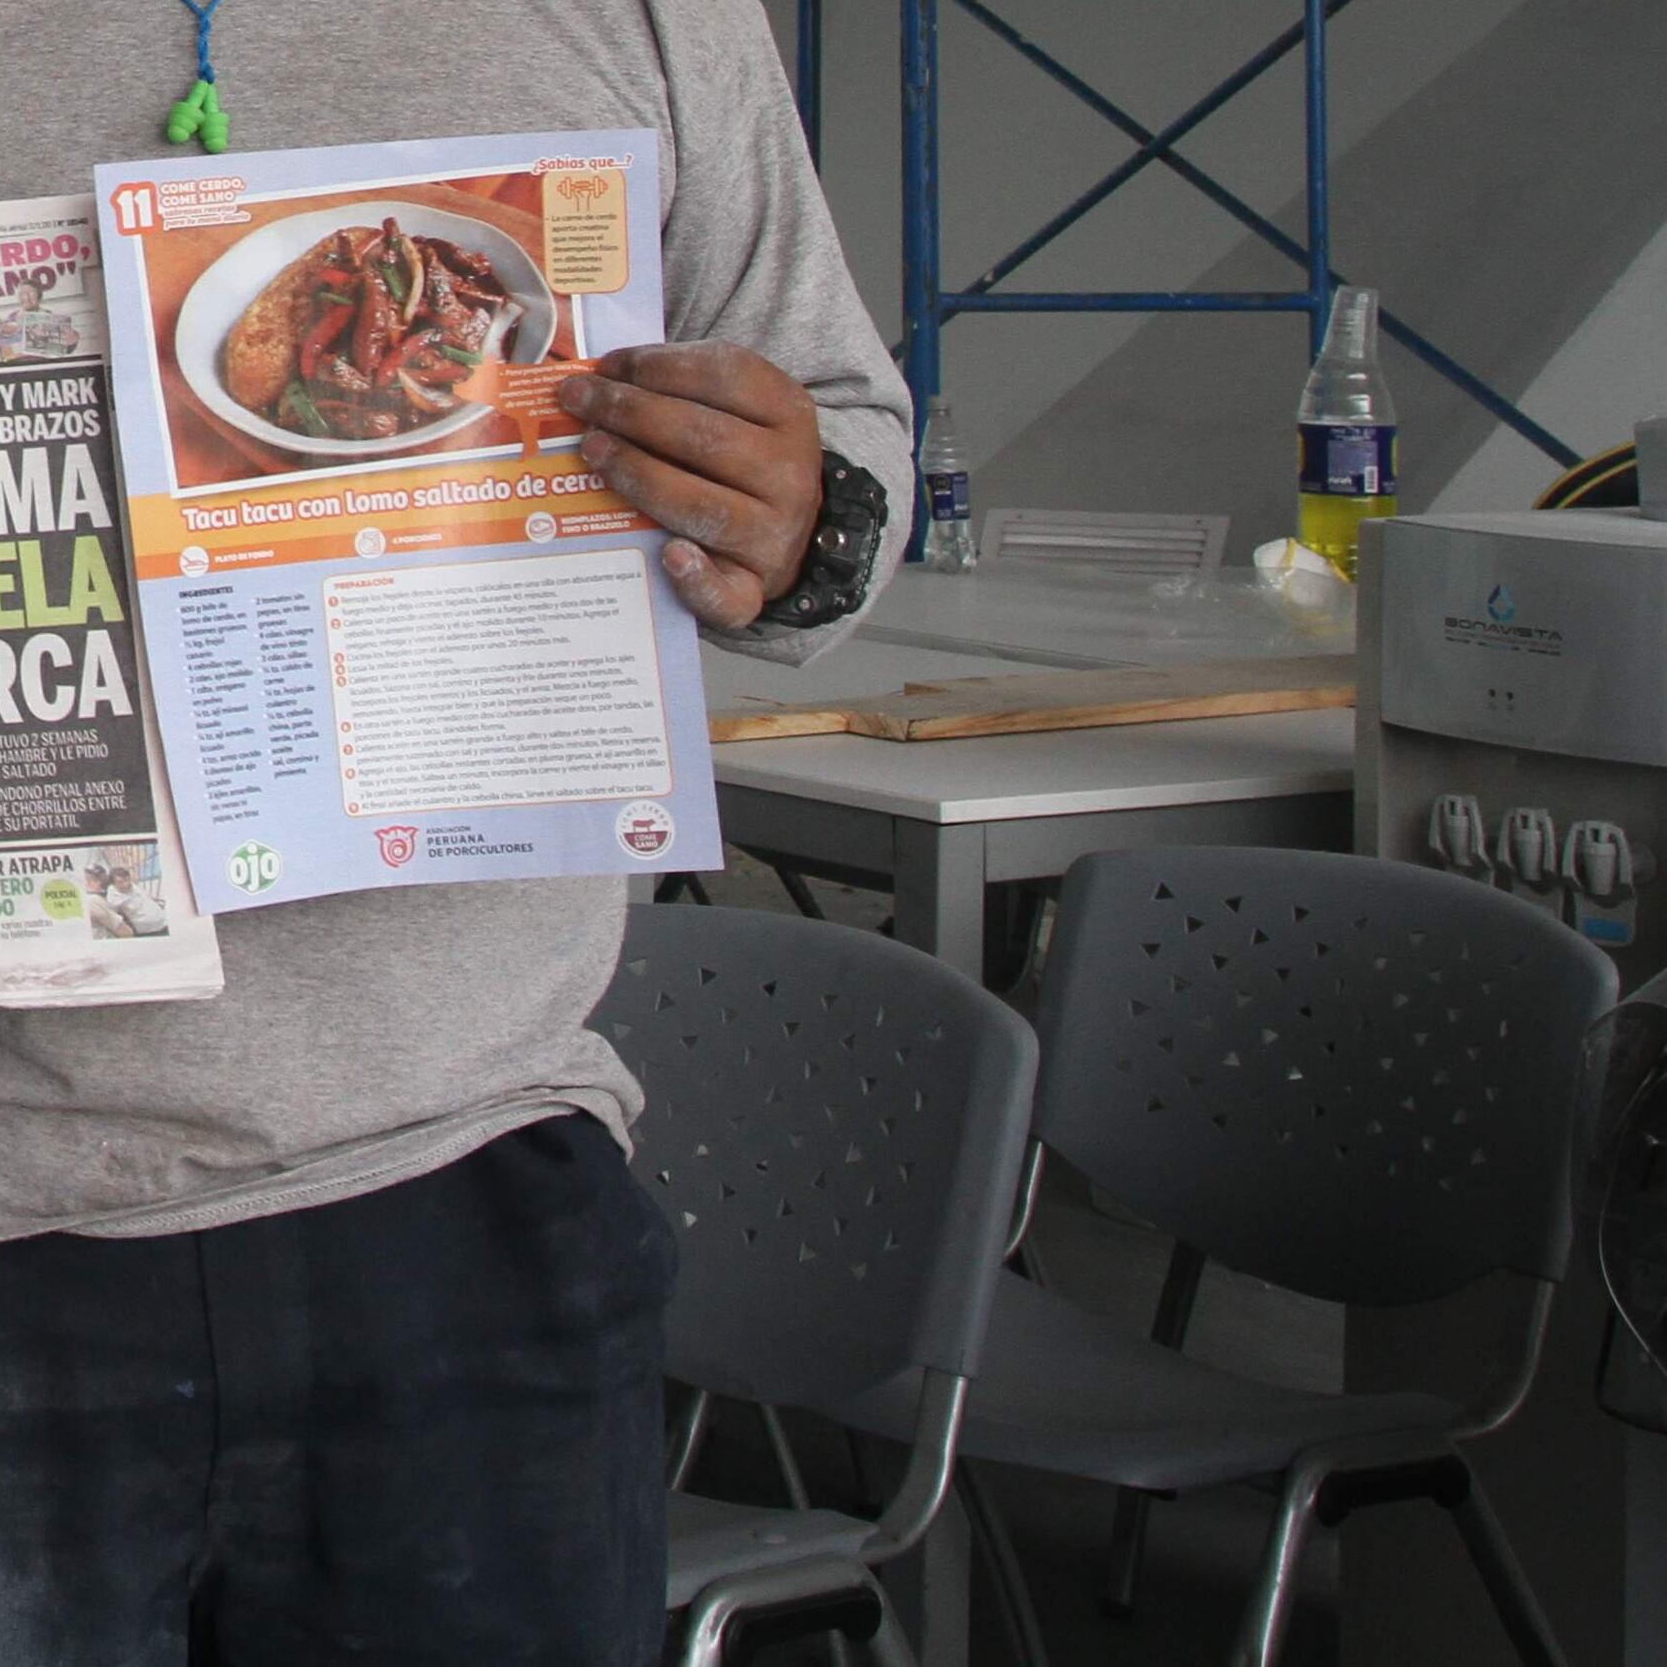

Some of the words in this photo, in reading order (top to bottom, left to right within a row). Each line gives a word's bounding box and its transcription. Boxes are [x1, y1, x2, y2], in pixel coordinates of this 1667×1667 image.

[161, 183, 195, 194] COME
[162, 194, 196, 206] COME
[200, 191, 234, 203] SANO
[117, 189, 153, 228] 11
[21, 377, 98, 409] MARK
[182, 506, 236, 531] Tacu
[242, 499, 293, 525] tacu
[298, 496, 340, 518] con
[346, 485, 408, 515] lomo
[413, 477, 512, 507] saltado
[516, 473, 546, 498] de
[427, 834, 485, 846] PERUANA
[428, 847, 444, 857] DE
[446, 842, 534, 857] PORCICULTORES
[9, 856, 74, 874] ATRAPA
[228, 841, 280, 893] ojo
